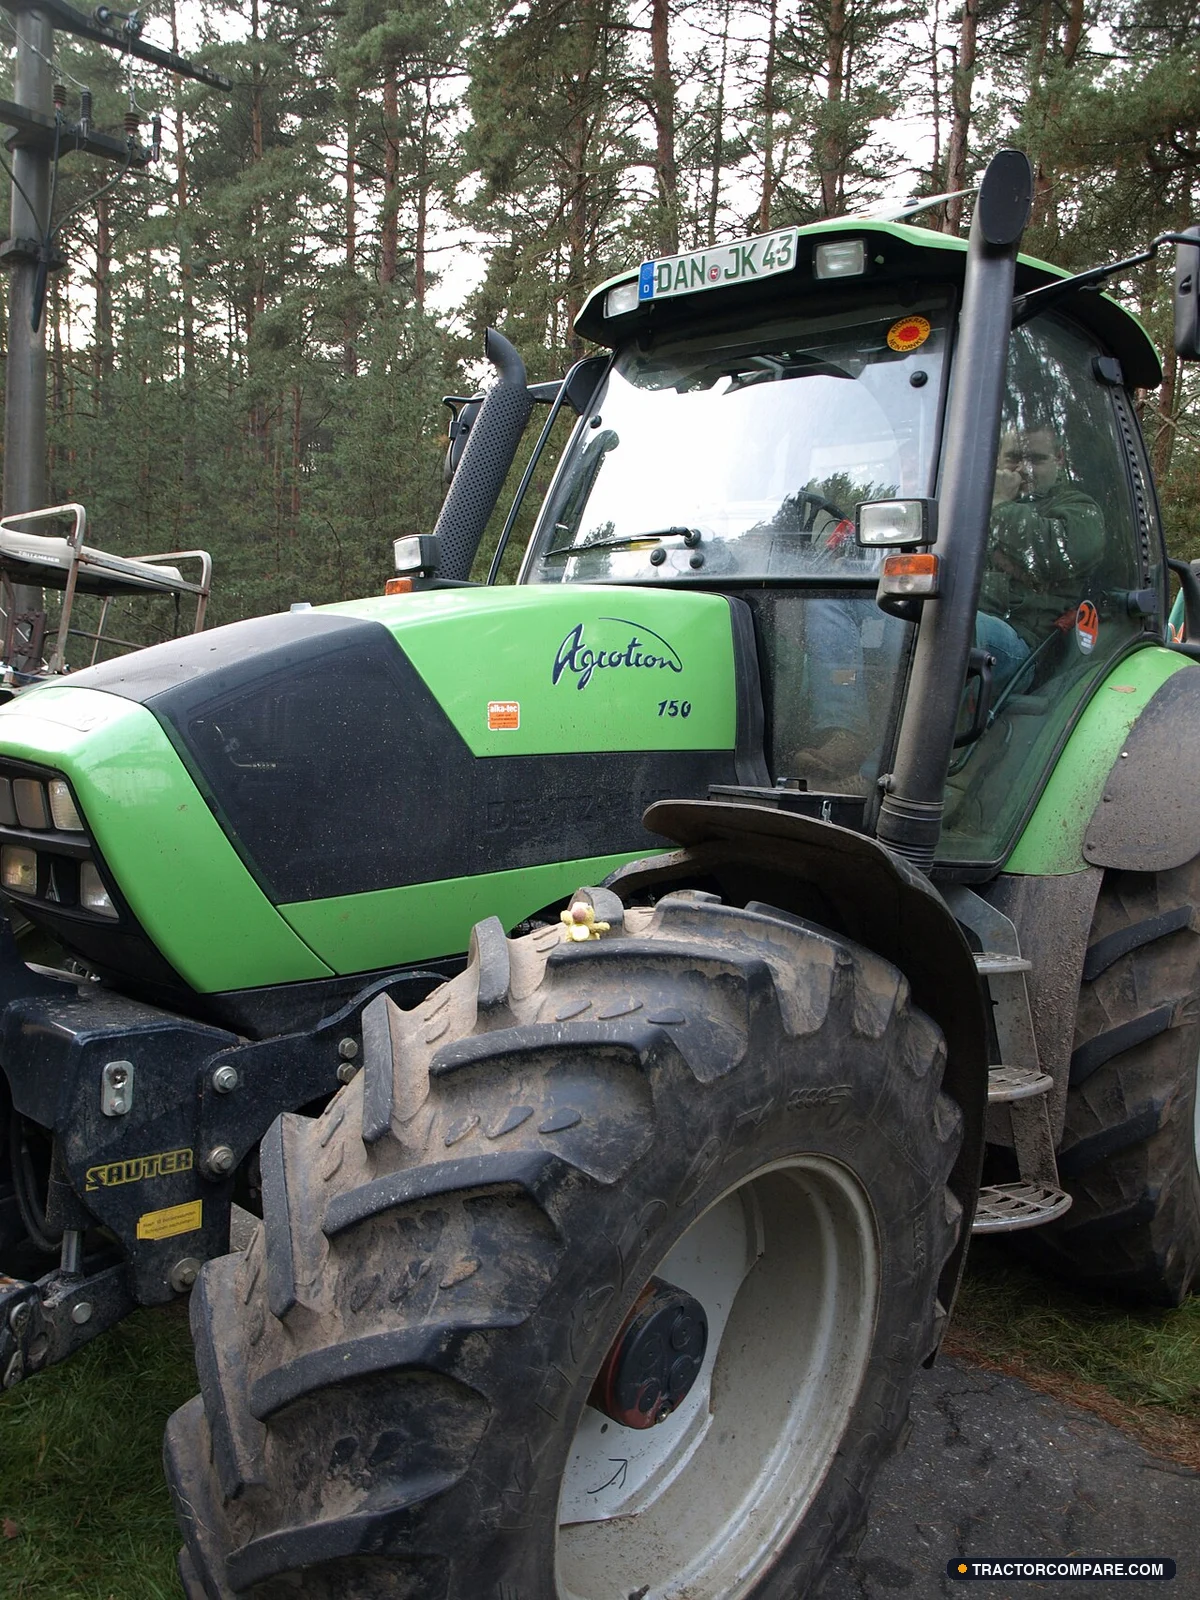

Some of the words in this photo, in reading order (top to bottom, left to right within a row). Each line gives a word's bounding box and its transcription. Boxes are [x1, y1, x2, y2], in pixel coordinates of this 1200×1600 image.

[656, 255, 706, 293] DAN
[724, 243, 758, 280] JK
[762, 233, 793, 270] 43
[552, 620, 683, 690] Agrotron
[658, 700, 692, 718] 150
[86, 1148, 193, 1191] SAUTER
